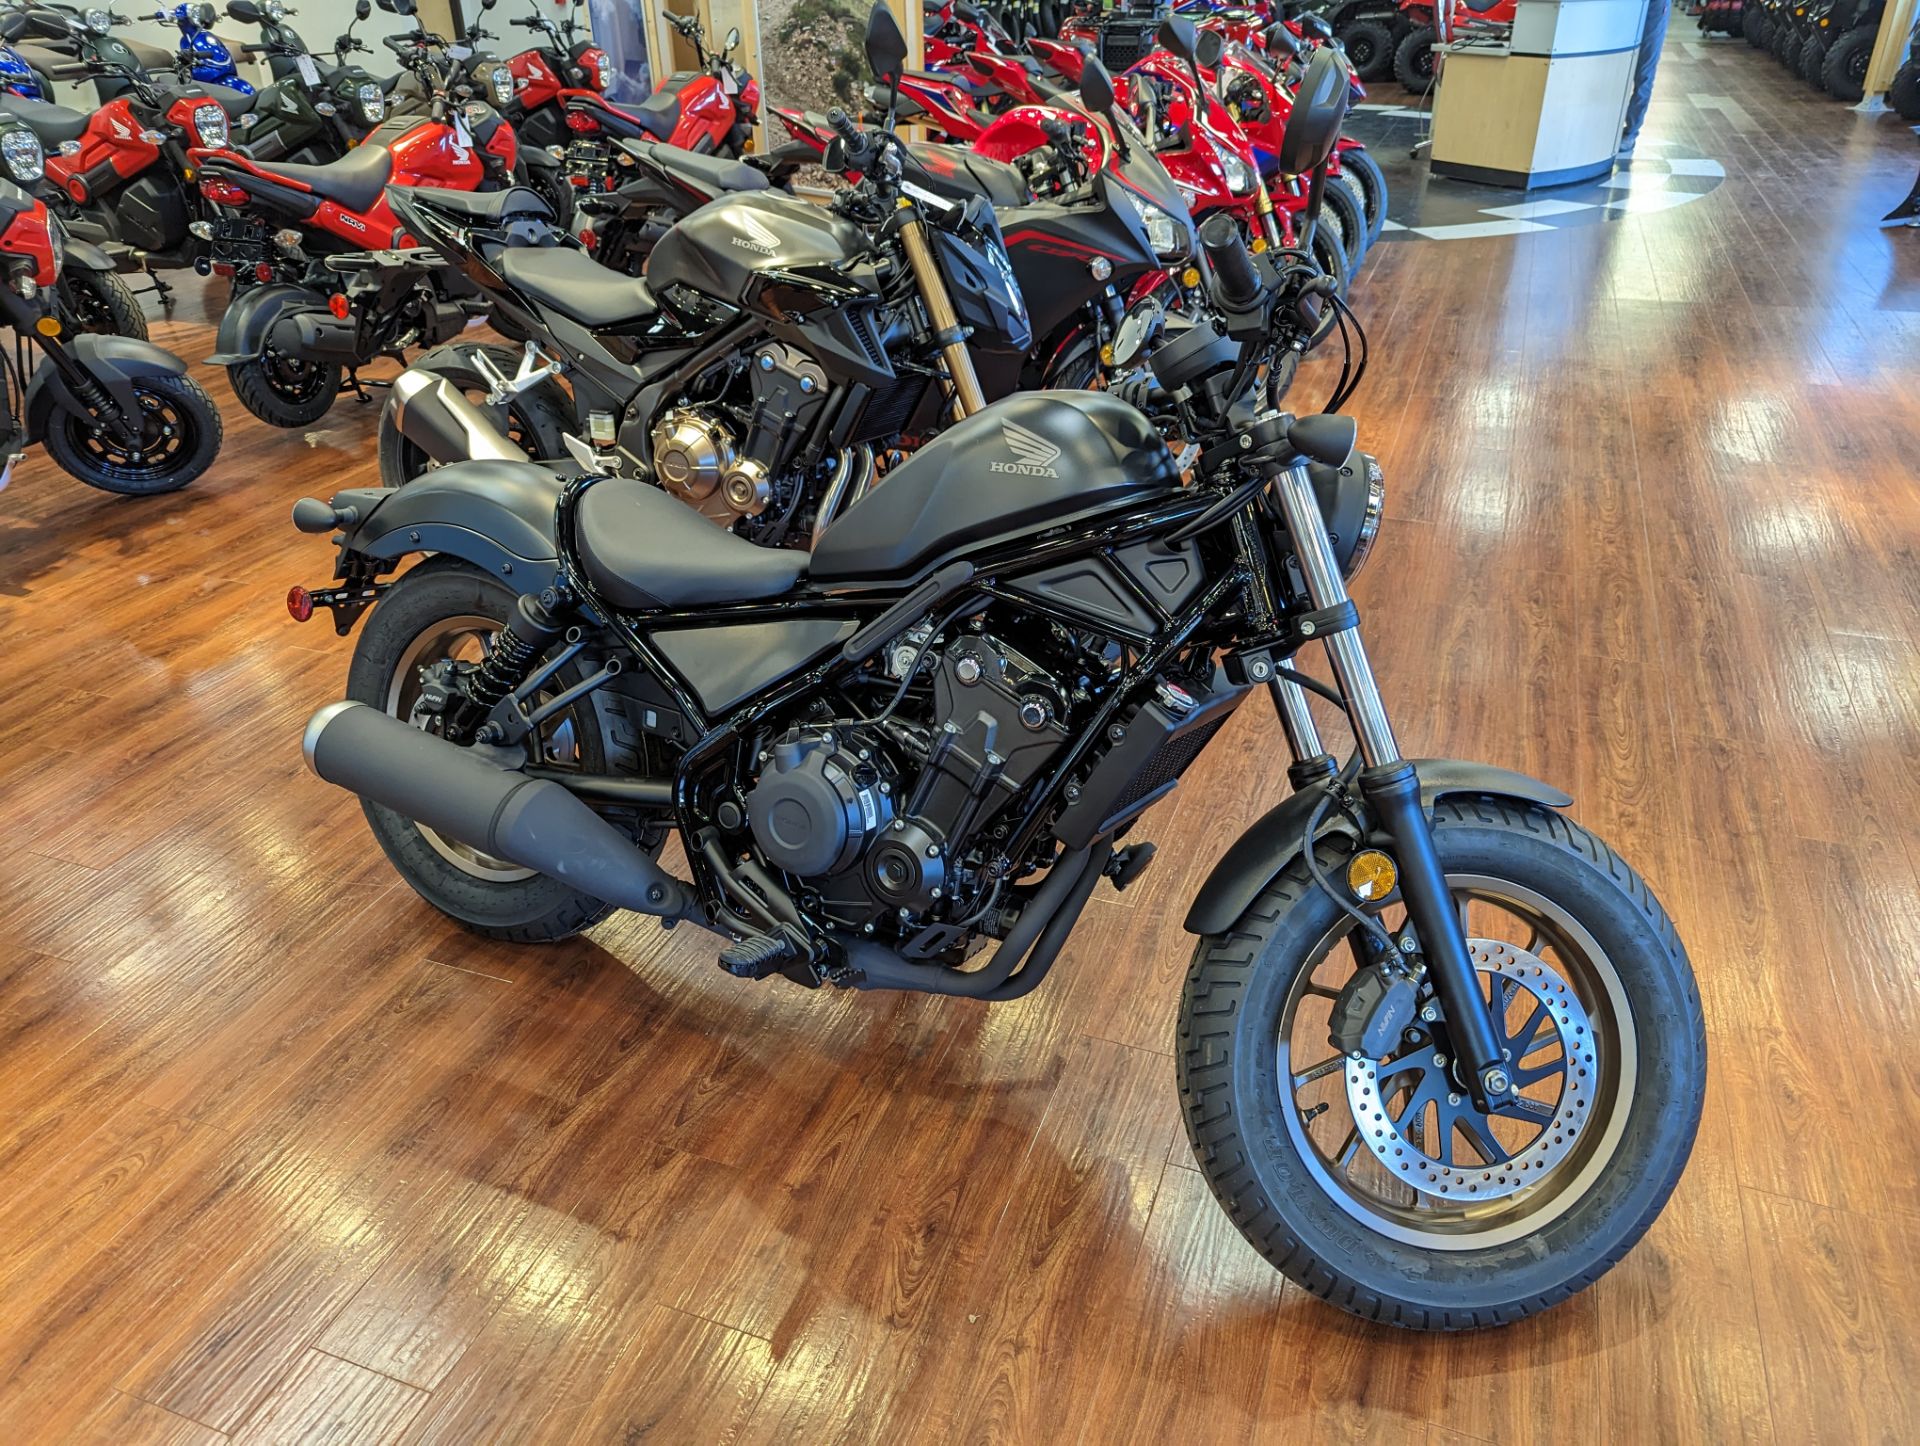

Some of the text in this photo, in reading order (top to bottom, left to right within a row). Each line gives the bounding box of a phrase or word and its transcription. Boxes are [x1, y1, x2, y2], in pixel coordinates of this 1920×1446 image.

[340, 213, 366, 232] NAVI
[731, 236, 777, 258] HONDA
[989, 461, 1060, 479] HONDA
